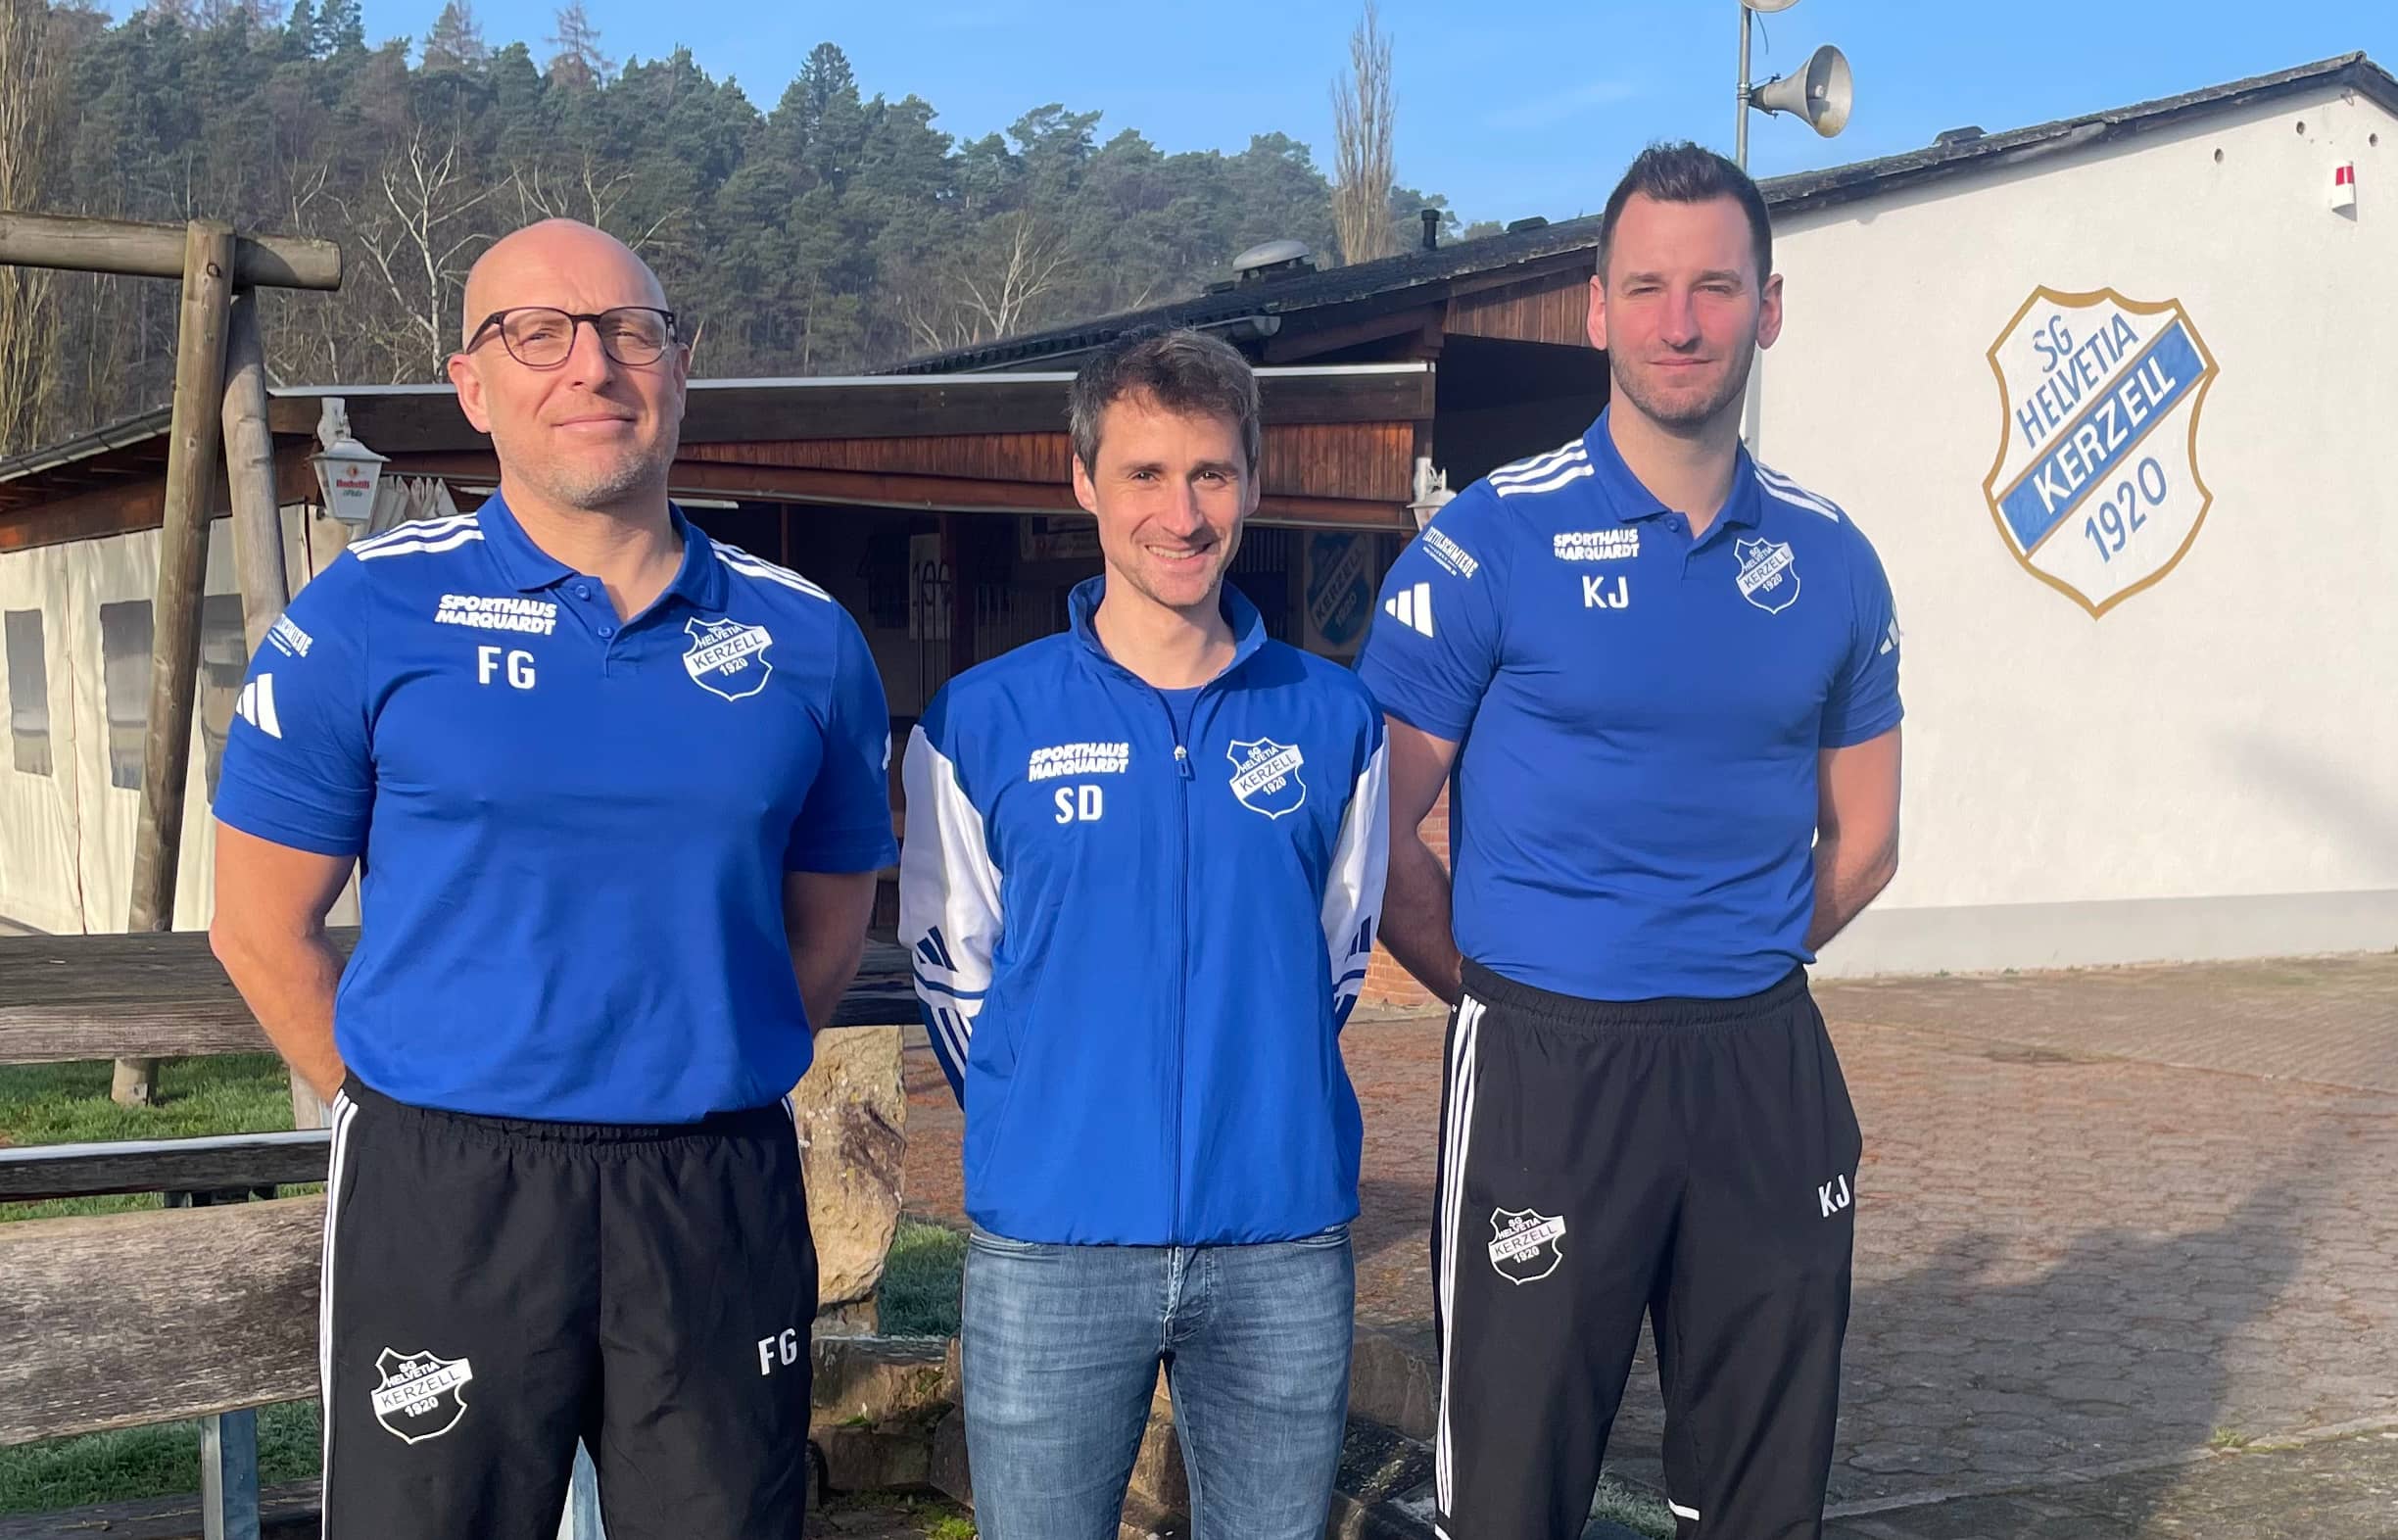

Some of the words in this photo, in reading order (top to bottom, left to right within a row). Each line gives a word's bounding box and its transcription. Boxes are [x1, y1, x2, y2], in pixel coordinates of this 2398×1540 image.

[2032, 314, 2074, 373] SG
[2015, 313, 2139, 450] HELVETIA
[2033, 356, 2177, 515] KERZELL
[2085, 457, 2168, 564] 1920
[1554, 528, 1639, 548] SPORTHAUS
[1554, 543, 1640, 561] MARQUARDT
[1744, 551, 1790, 589] KERZELL
[1763, 573, 1783, 593] 1920
[439, 594, 557, 618] SPORTHAUS
[1582, 575, 1629, 608] KJ
[434, 608, 556, 636] MARQUARDT
[478, 646, 536, 690] FG
[693, 633, 764, 670] KERZELL
[720, 657, 749, 677] 1920
[1029, 743, 1129, 766] SPORTHAUS
[1029, 757, 1129, 783] MARQUARDT
[1239, 753, 1297, 792] KERZELL
[1263, 776, 1287, 795] 1920
[1054, 785, 1103, 824] SD
[1818, 1174, 1850, 1218] KJ
[1494, 1224, 1558, 1257] KERZELL
[1497, 1217, 1542, 1239] HELVETIA
[1513, 1245, 1540, 1264] 1920
[758, 1327, 797, 1375] FG
[381, 1371, 461, 1409] KERZELL
[387, 1361, 441, 1387] HELVETIA
[405, 1396, 439, 1418] 1920
